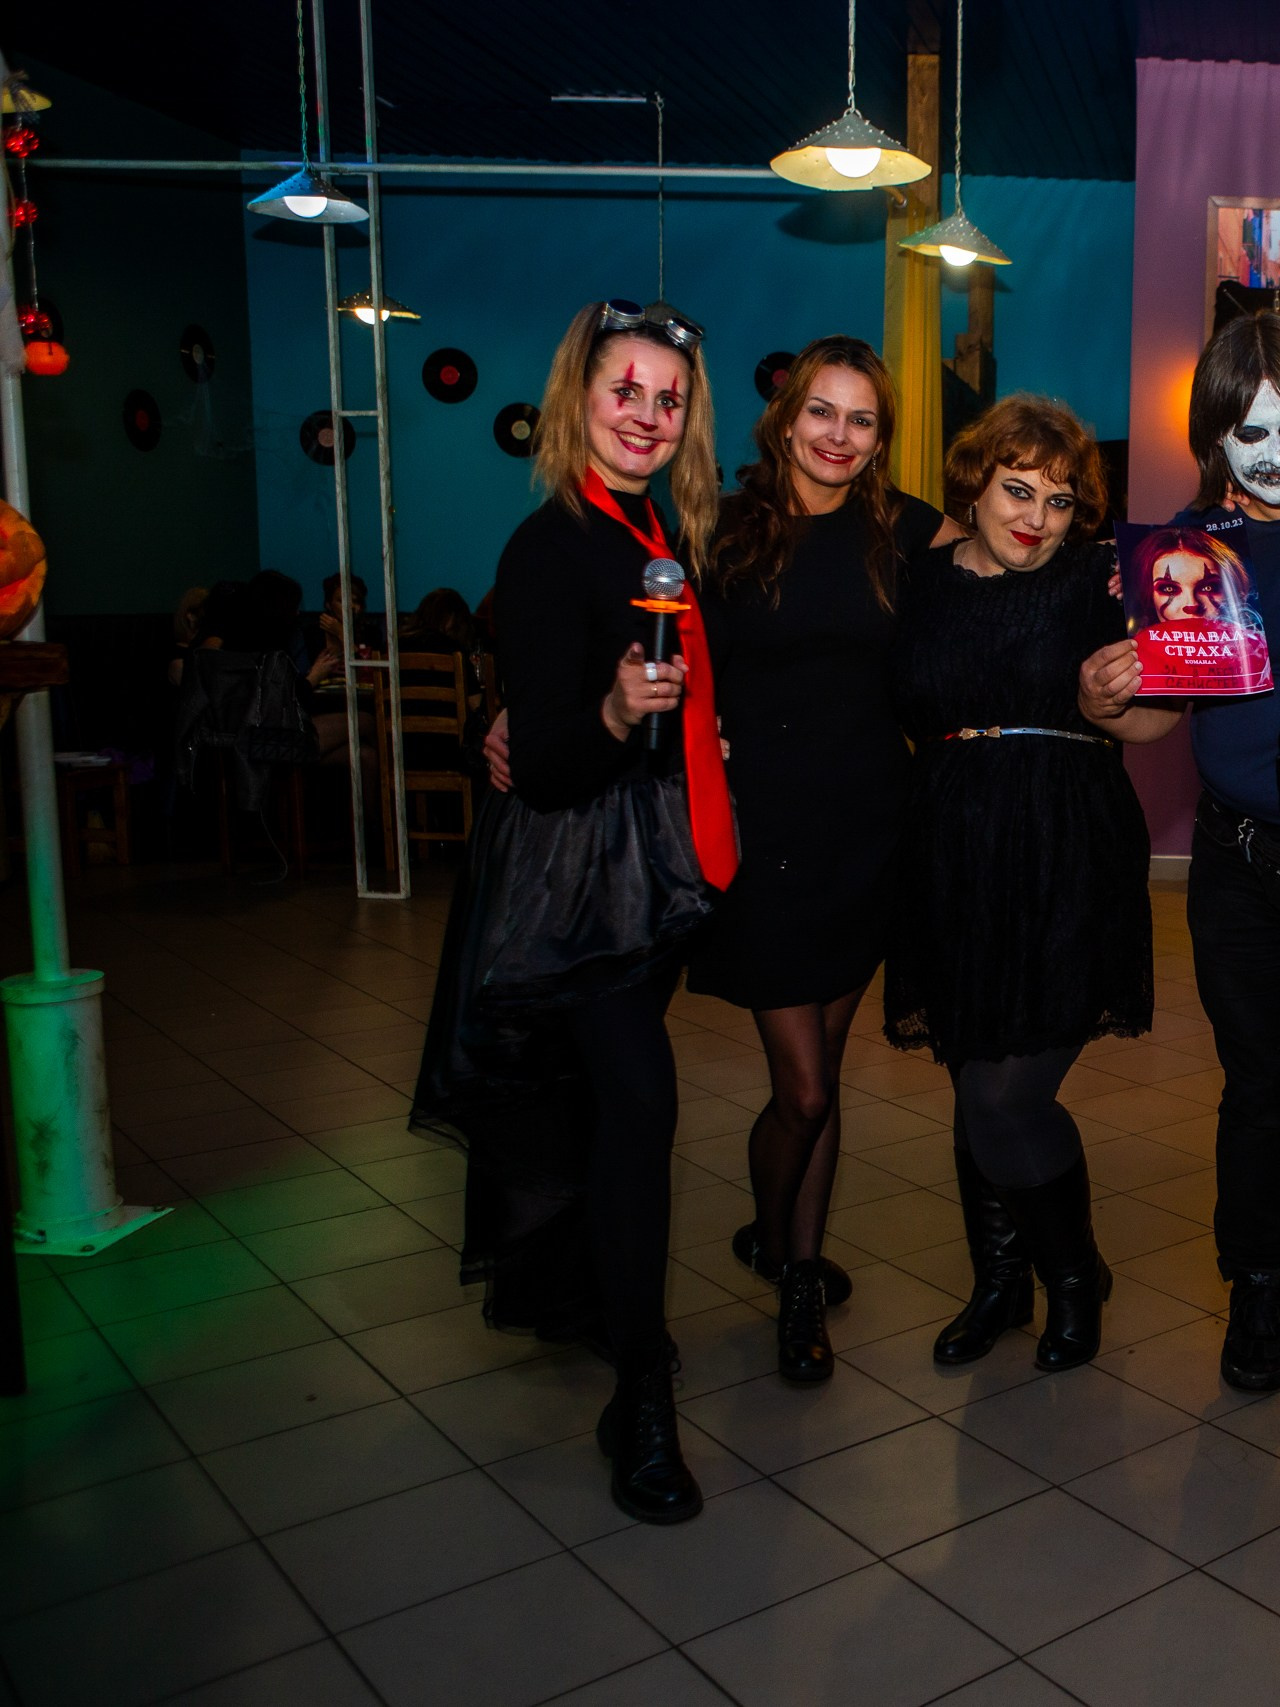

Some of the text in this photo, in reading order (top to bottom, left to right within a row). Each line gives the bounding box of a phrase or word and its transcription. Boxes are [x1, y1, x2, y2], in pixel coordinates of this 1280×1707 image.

[1206, 517, 1244, 532] 28.10.23
[1148, 629, 1244, 643] КАРНАВАЛ
[1164, 644, 1234, 657] СТРАХА
